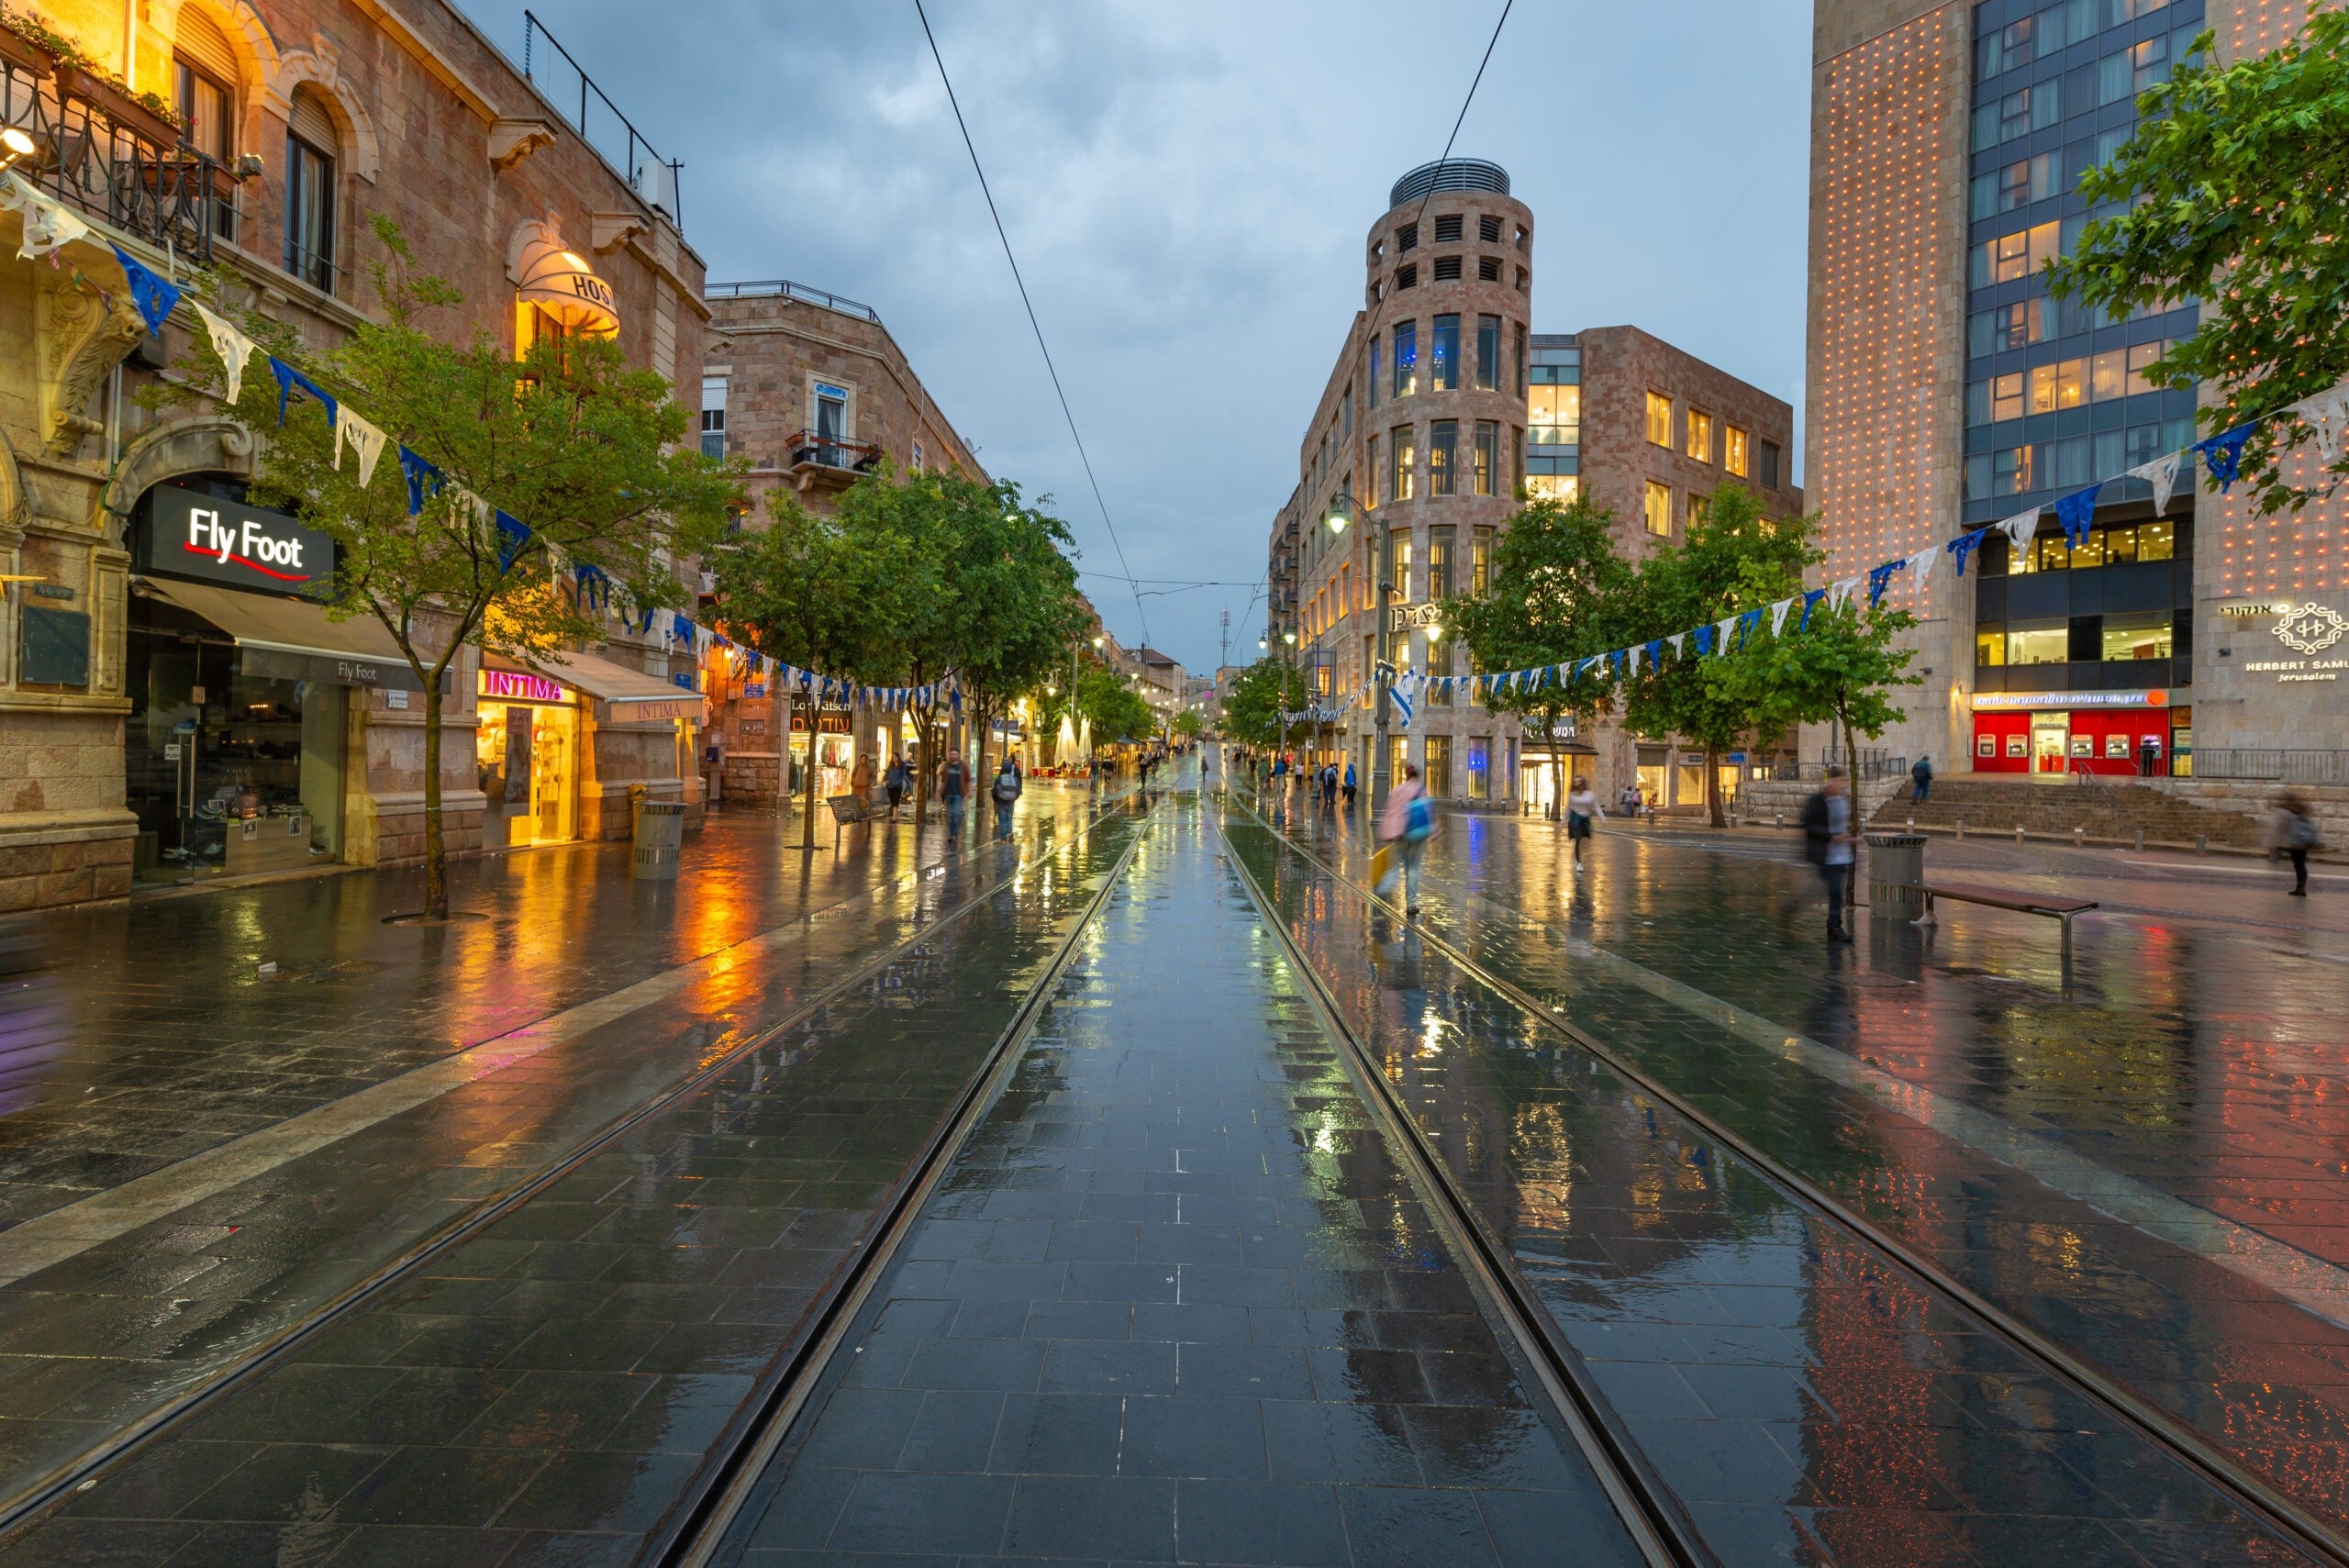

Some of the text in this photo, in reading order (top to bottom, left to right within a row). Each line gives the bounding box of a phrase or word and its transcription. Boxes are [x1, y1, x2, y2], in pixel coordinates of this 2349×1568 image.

[190, 507, 303, 568] Fly Foot
[2221, 605, 2272, 617] אנקורי
[339, 662, 377, 682] Fly Foot
[2246, 662, 2306, 671] HERBERT
[484, 671, 564, 701] INTIMA
[638, 703, 681, 719] INTIMA
[793, 717, 850, 732] עודם
